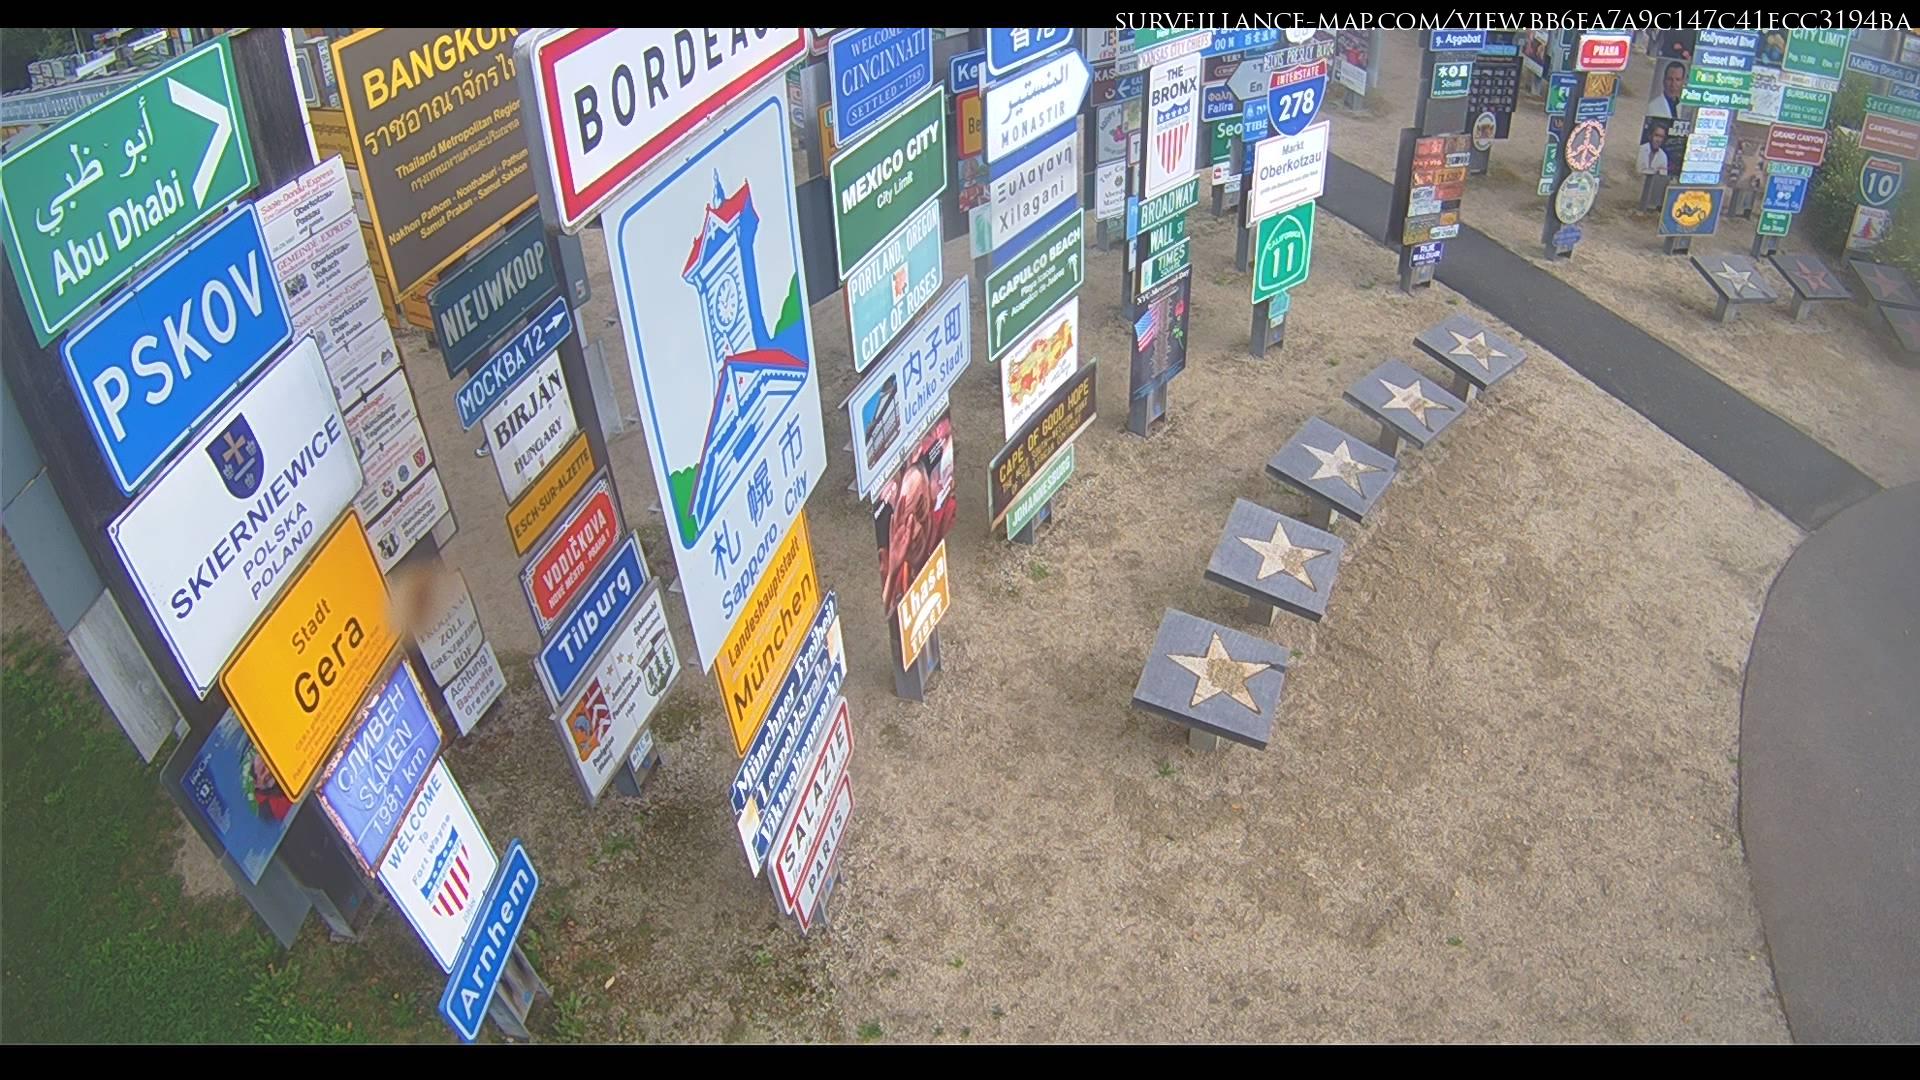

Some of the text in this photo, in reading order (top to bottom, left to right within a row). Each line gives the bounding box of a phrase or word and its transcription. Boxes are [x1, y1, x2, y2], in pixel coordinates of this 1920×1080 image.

[842, 28, 927, 97] CINCINNATI
[957, 62, 979, 83] Ke
[1166, 64, 1184, 81] THE
[1276, 65, 1320, 86] INTERSTATE
[1592, 45, 1619, 57] PRAHA
[1699, 31, 1738, 49] Hollywood
[1702, 51, 1746, 68] Sunset Blvd
[1792, 28, 1847, 49] CITY LIMIT
[1850, 56, 1879, 73] Malibu
[573, 28, 781, 156] BORDEA
[850, 85, 898, 118] SETTLED
[1151, 75, 1198, 107] BRONX
[1279, 87, 1315, 122] 278
[1681, 89, 1751, 106] Palm Canyon Drive
[1695, 70, 1715, 82] Palm
[1715, 72, 1744, 88] Springs
[395, 116, 494, 179] Thailand Metropolitan
[968, 116, 982, 135] Be
[1001, 100, 1066, 149] MONASTIR
[1217, 121, 1243, 138] Seo
[1281, 139, 1305, 155] Markt
[1772, 130, 1825, 144] GRAND CANYON
[841, 119, 940, 214] MEXICO CITY
[876, 170, 914, 209] City Limit
[1259, 150, 1323, 181] Oberkotzau
[1867, 172, 1895, 198] 10
[54, 231, 110, 297] Abu
[107, 169, 185, 251] Dhabi
[388, 219, 422, 247] Nakhon
[421, 197, 453, 222] Pathom
[456, 167, 498, 198] Nonthaburi
[420, 216, 446, 240] Samut
[446, 200, 474, 222] Prakan
[477, 180, 502, 201] Samut
[999, 175, 1065, 234] Xilagani
[1140, 181, 1196, 229] BROADWAY
[1150, 221, 1184, 254] WALL ST
[850, 206, 938, 305] PORTLAND, OREGON
[991, 227, 1081, 308] ACAPULCO BEACH
[1157, 243, 1186, 272] TIMES
[1271, 241, 1296, 279] 11
[441, 240, 546, 348] NIEUWKOOP
[861, 266, 938, 362] CITY OF ROSES
[92, 250, 263, 443] PSKOV
[459, 325, 546, 421] МОСКВА 12
[902, 301, 962, 401] 内子町
[904, 340, 964, 425] Uchiko Stadt
[493, 368, 564, 450] BIRJÁN
[513, 415, 563, 475] HUNGARY
[999, 442, 1025, 483] CAPE
[1027, 426, 1041, 451] OF
[1041, 402, 1065, 437] GOOD
[1067, 376, 1090, 410] HOPE
[171, 414, 342, 619] SKIERNIEWICE
[513, 447, 591, 539] ESCH-SUR-ALZETTE
[711, 413, 804, 582] 札幌市
[242, 501, 308, 580] POLSKA
[251, 519, 314, 601] POLAND
[542, 508, 607, 592] VODIČKOVA
[721, 470, 808, 620] Sapporo City
[292, 598, 332, 656] Stadt
[557, 567, 632, 664] Tilburg
[727, 535, 801, 668] Landeshauptstadt
[900, 556, 945, 631] Lhasa
[294, 616, 365, 713] Gera
[733, 572, 813, 723] München
[337, 683, 406, 792] СЛИВЕН
[737, 599, 836, 805] Münchner Freiheit
[372, 746, 427, 835] 1981 km
[759, 670, 841, 844] Viktualienmarkt
[388, 773, 443, 871] WELCOME
[782, 720, 846, 873] SALAZIE
[412, 813, 452, 887] Fort Wayne
[419, 832, 429, 844] To
[807, 809, 844, 895] PARIS
[460, 868, 530, 1021] Arnhem
